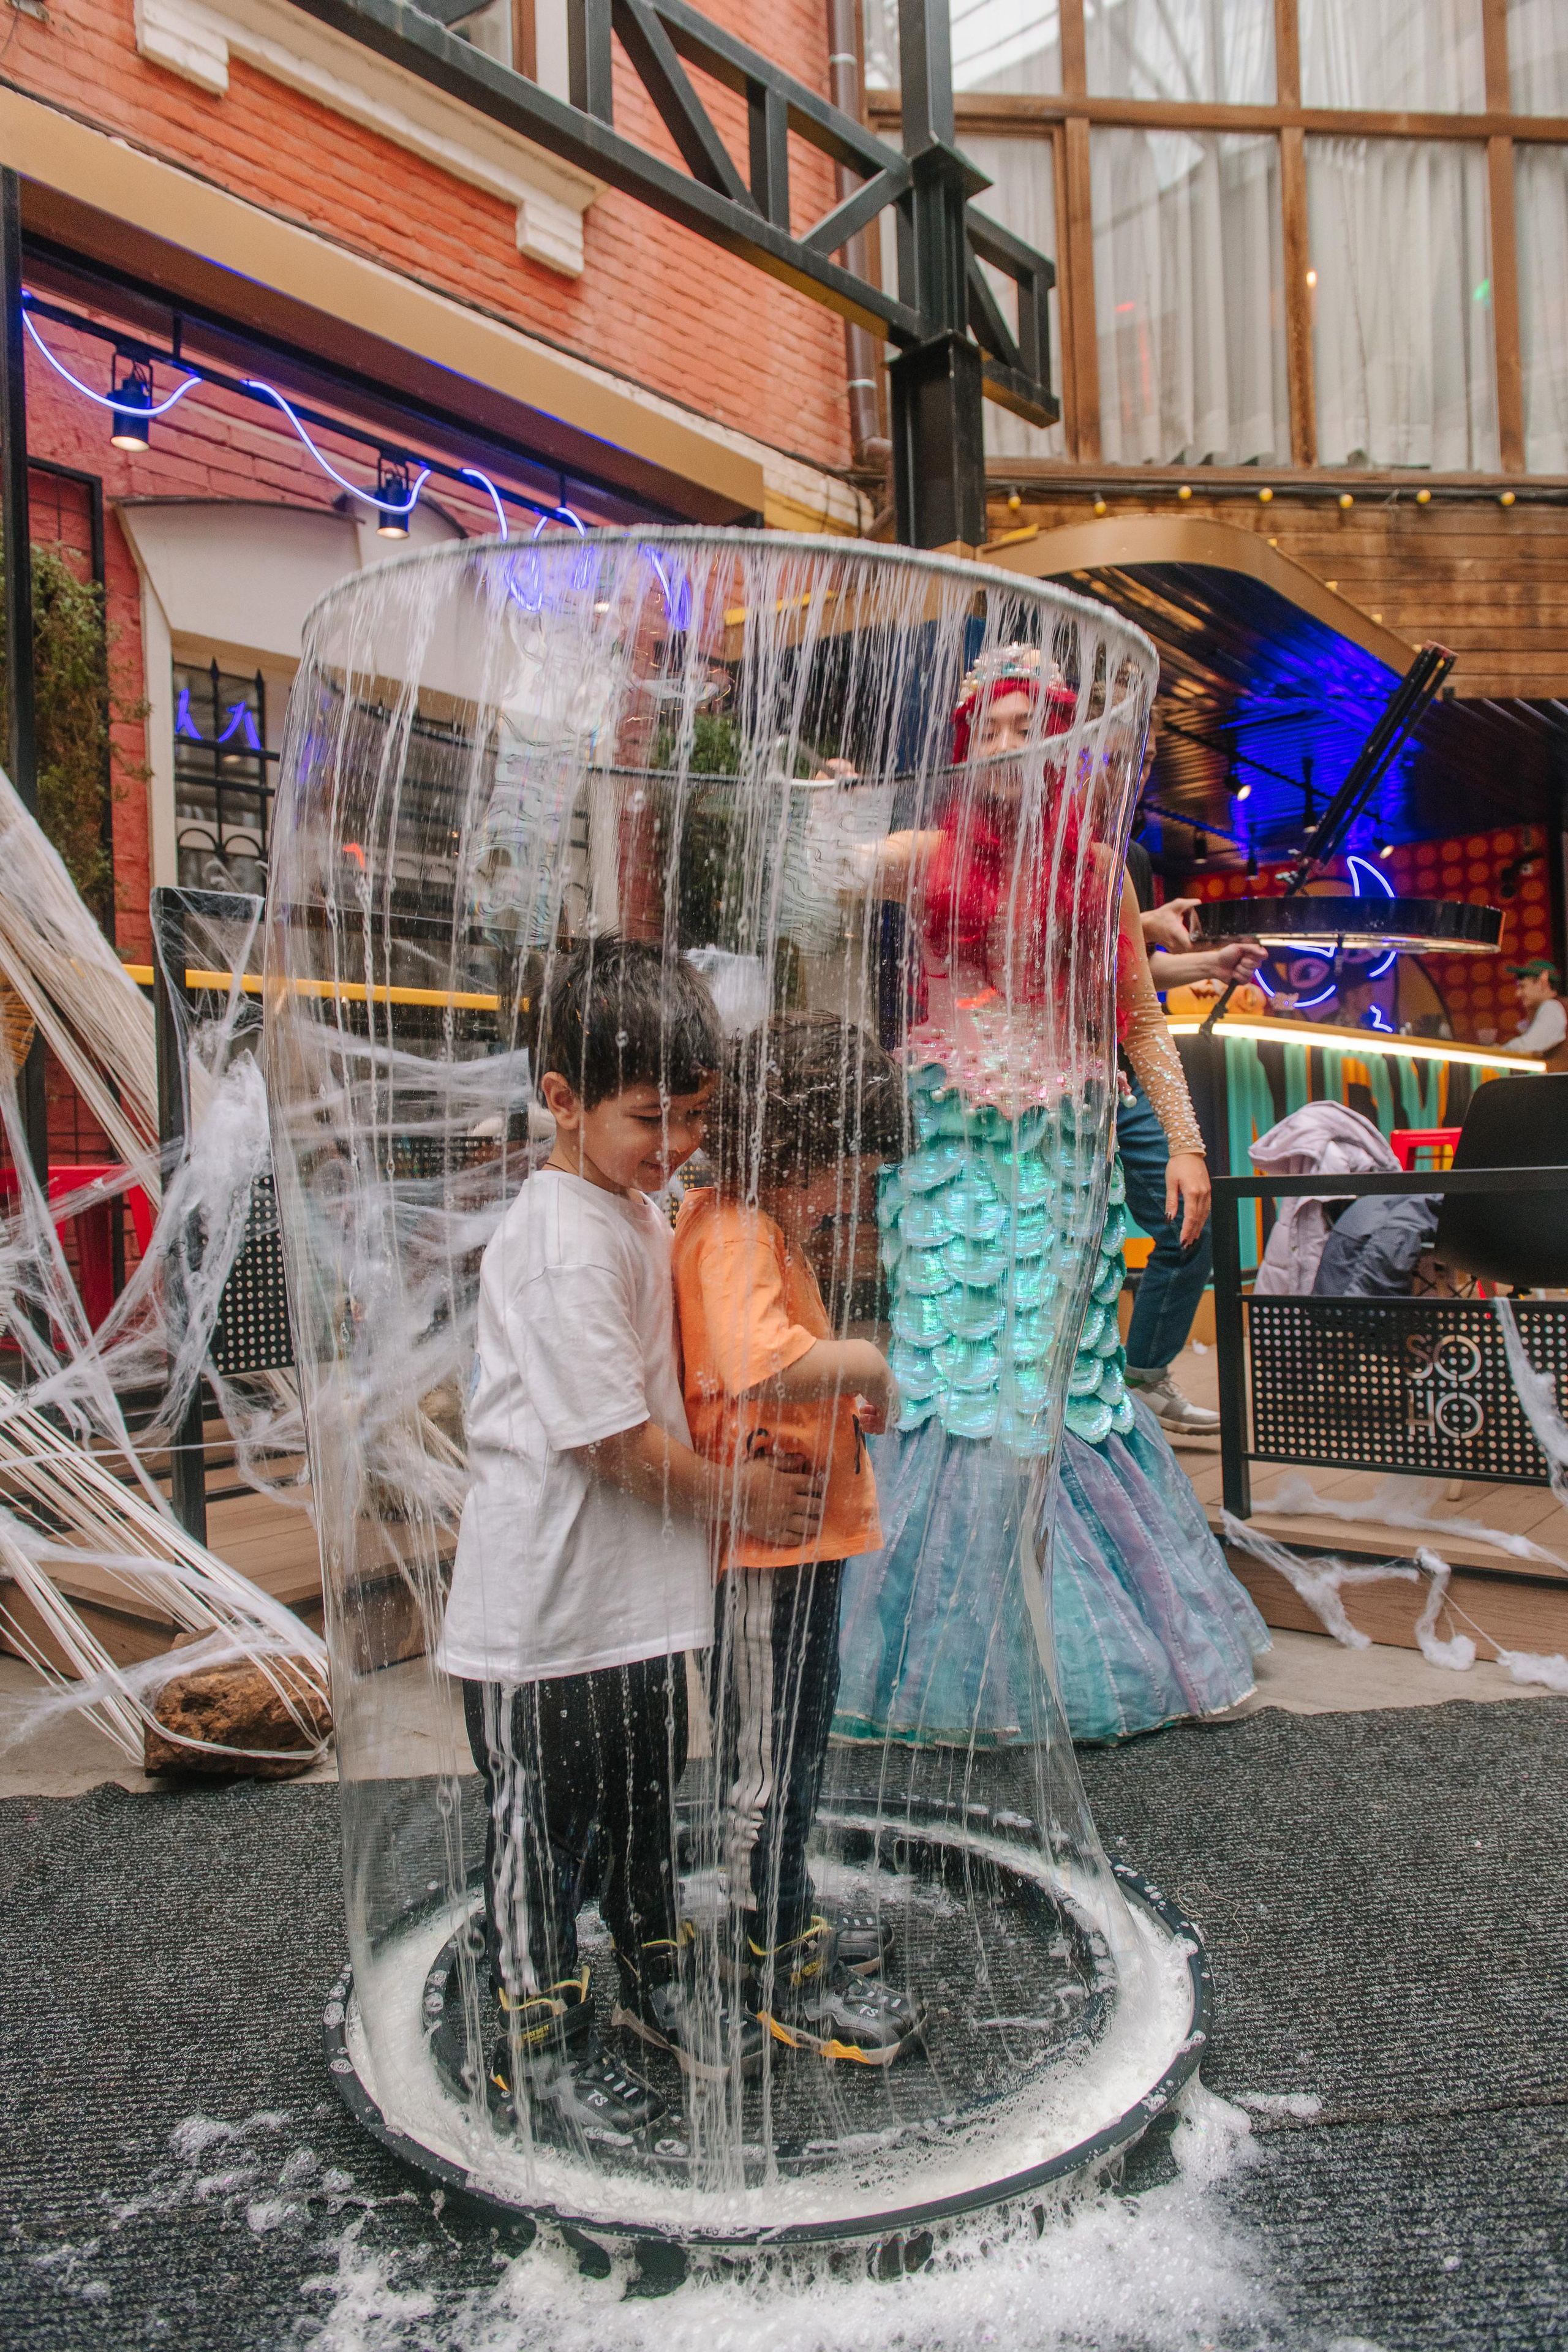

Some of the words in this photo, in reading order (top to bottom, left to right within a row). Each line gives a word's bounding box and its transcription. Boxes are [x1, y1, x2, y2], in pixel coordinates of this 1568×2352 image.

[1404, 1334, 1482, 1382] SO
[1405, 1389, 1484, 1439] HO
[859, 2003, 878, 2018] TS
[587, 2089, 609, 2106] TS
